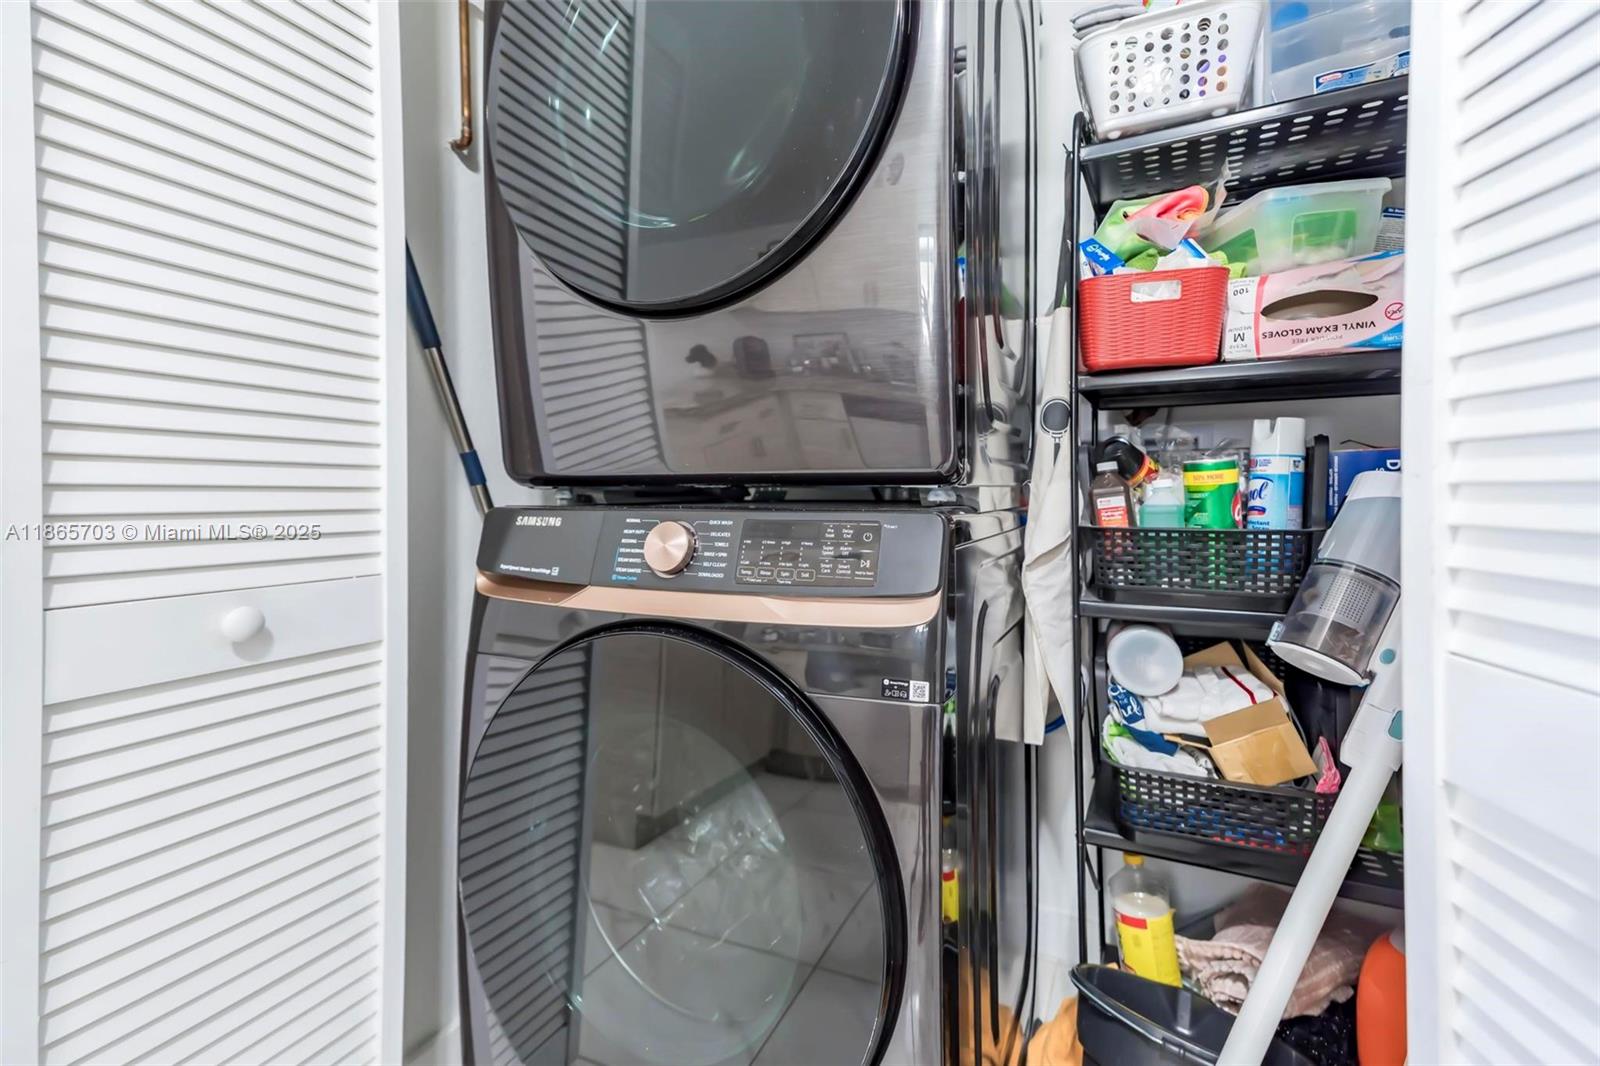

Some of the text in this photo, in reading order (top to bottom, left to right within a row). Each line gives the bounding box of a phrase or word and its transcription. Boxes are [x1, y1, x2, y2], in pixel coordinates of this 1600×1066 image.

[1233, 287, 1249, 297] 100
[1262, 321, 1377, 339] VINYL EXAM GLOVES
[1233, 332, 1245, 343] M
[515, 515, 562, 527] SAMSUNG
